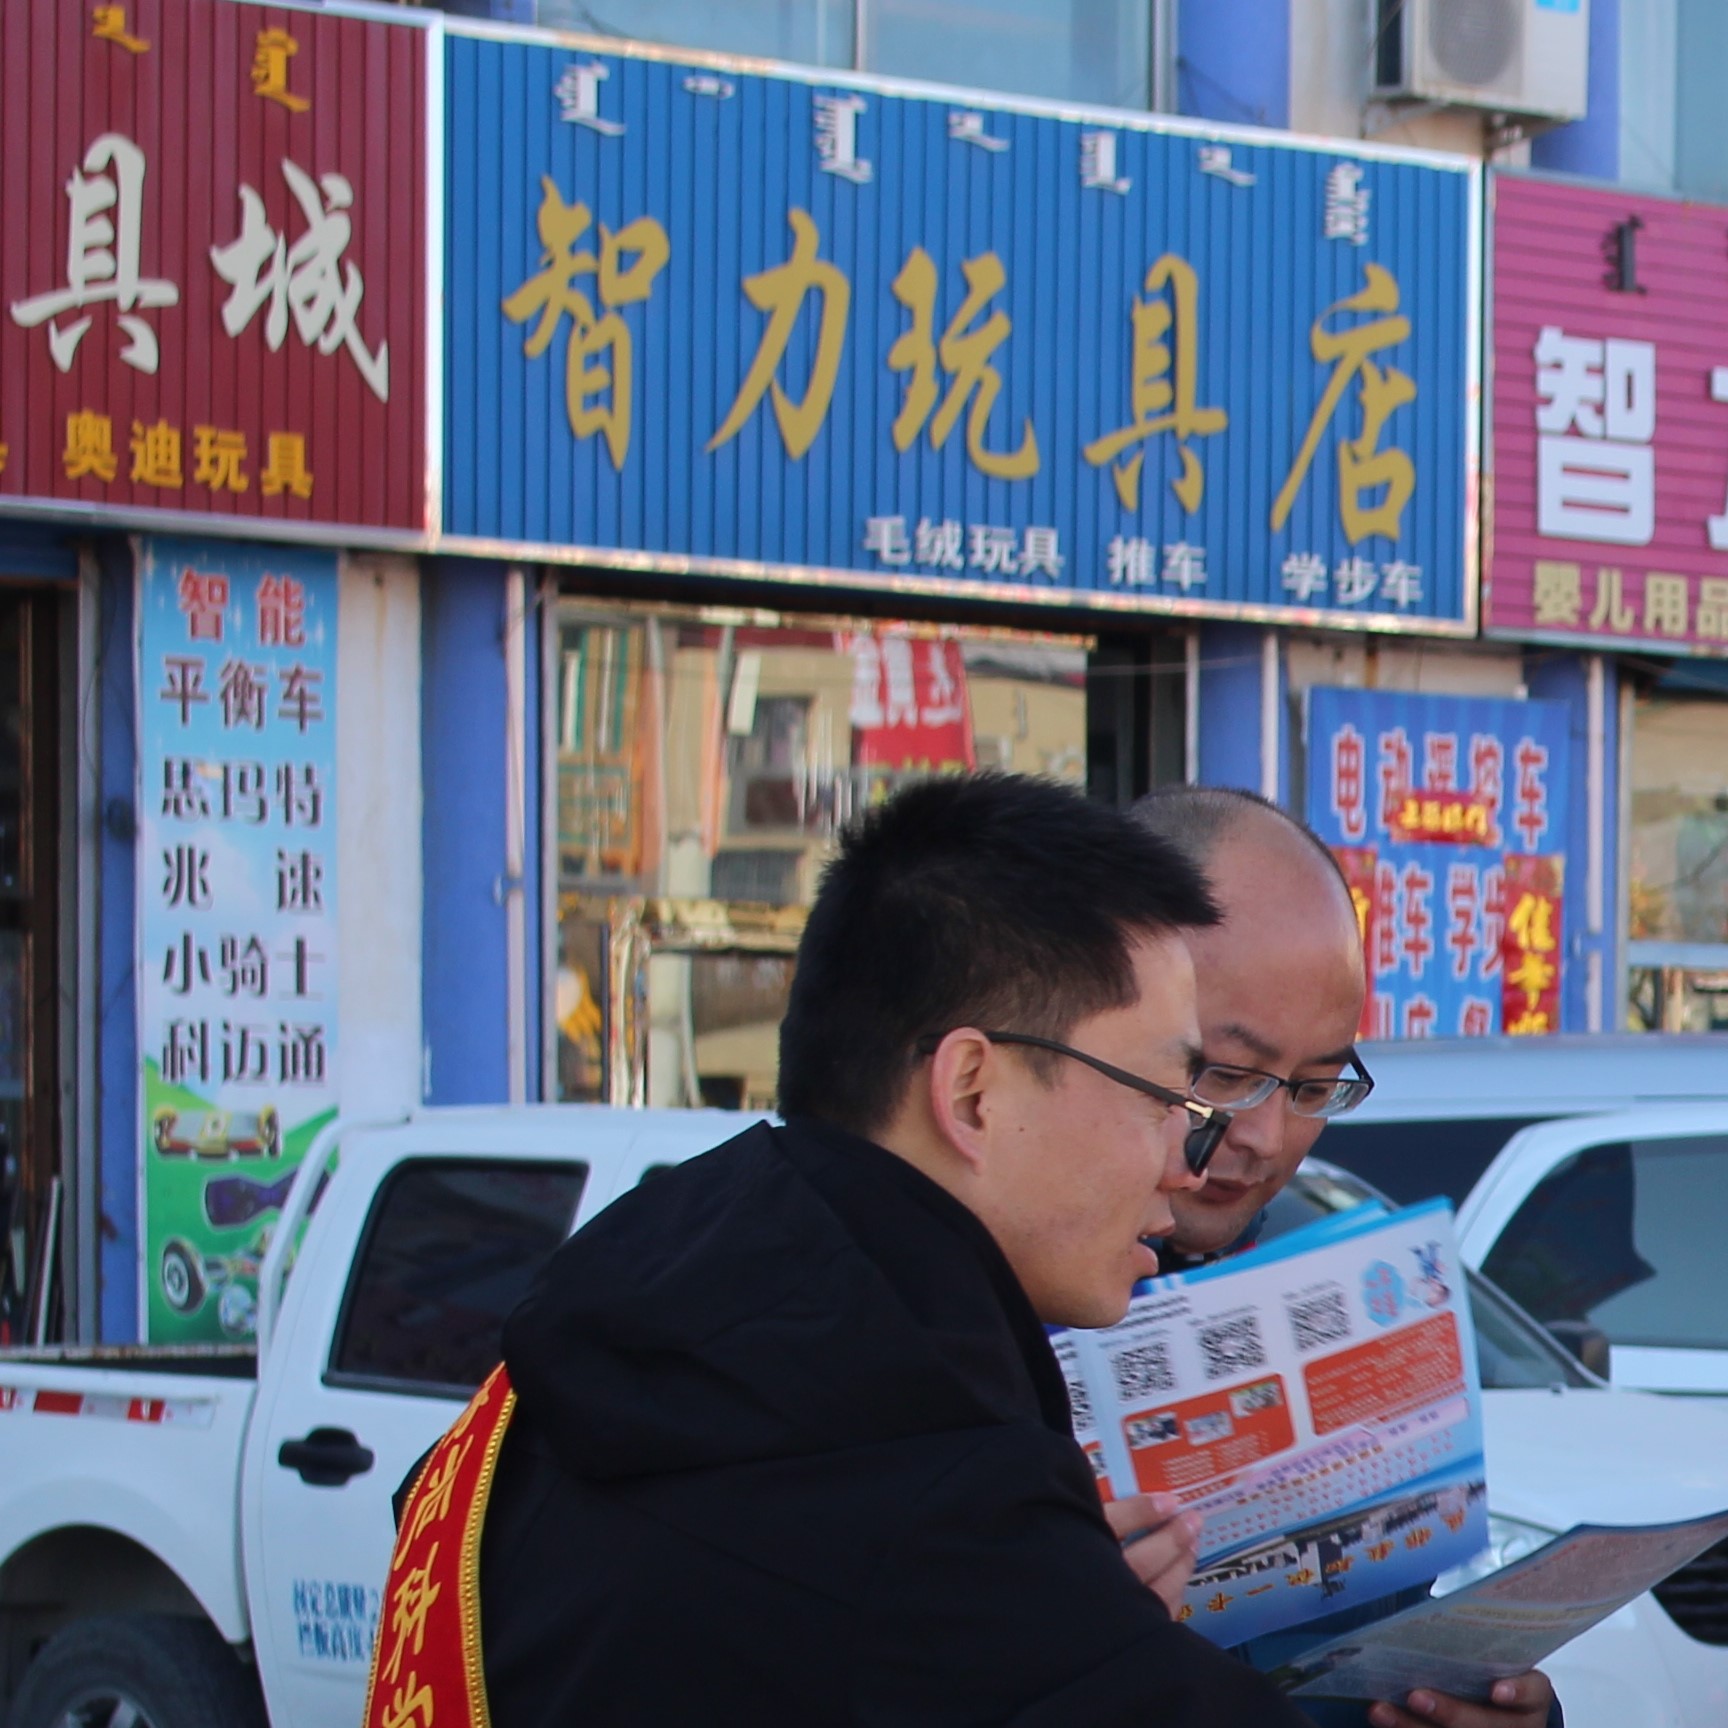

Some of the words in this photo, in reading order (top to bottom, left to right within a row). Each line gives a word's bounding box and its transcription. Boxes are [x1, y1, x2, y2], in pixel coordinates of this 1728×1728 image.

[10, 132, 391, 404] 具城
[501, 175, 1417, 544] 智力玩具店
[63, 409, 313, 498] 奥迪玩具
[863, 513, 1064, 581] 毛绒玩具
[1107, 533, 1209, 589] 推车
[1279, 552, 1423, 606] 学步车
[175, 567, 306, 649] 智能
[159, 654, 323, 733] 平衡车
[161, 934, 327, 998] 小骑士
[160, 1022, 329, 1087] 科迈通
